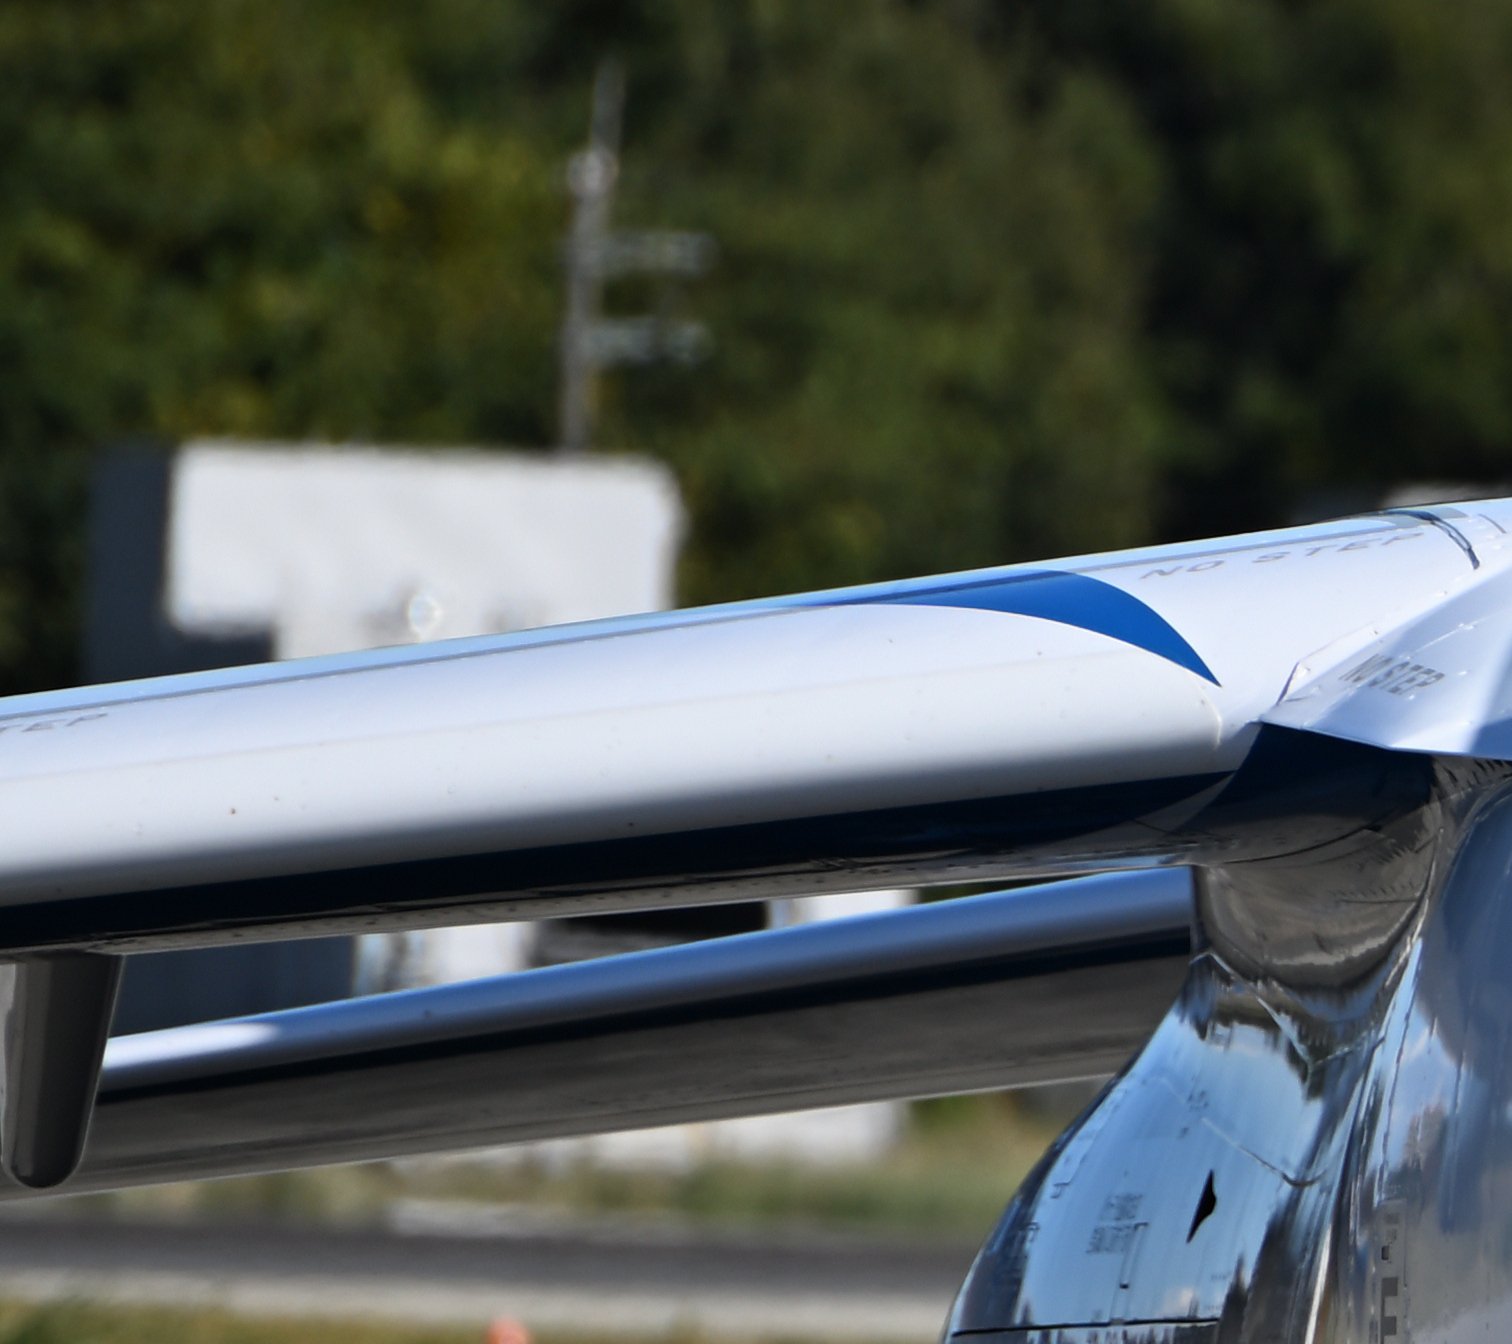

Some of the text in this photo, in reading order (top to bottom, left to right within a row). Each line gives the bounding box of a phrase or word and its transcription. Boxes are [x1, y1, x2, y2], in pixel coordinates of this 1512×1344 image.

[1139, 532, 1425, 579] NO STEP
[1367, 661, 1446, 695] STEP
